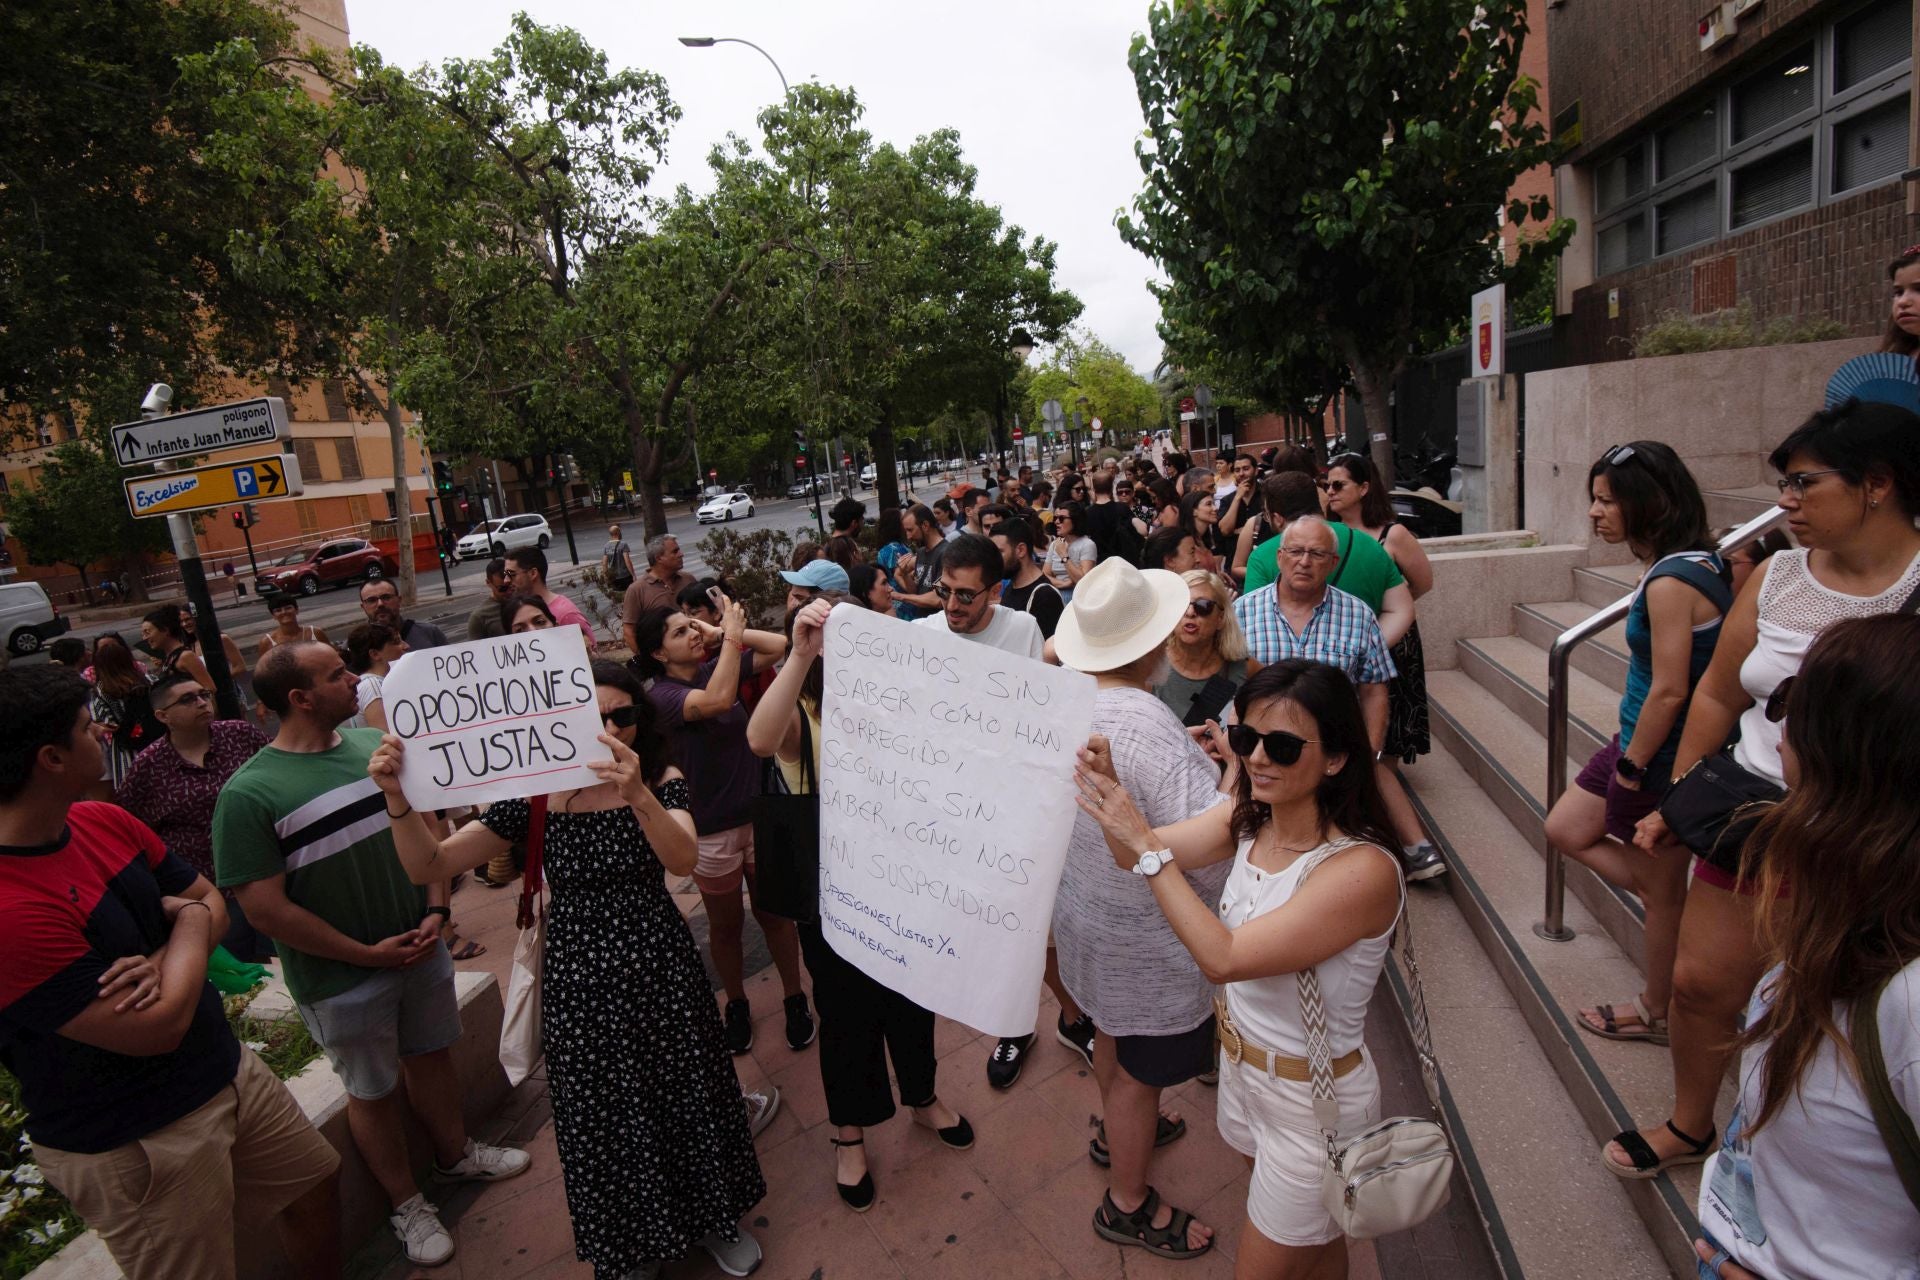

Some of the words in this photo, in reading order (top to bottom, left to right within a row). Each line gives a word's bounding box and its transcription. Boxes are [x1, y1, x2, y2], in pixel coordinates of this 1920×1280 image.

[146, 435, 190, 456] Infante
[193, 430, 221, 447] Juan
[223, 421, 271, 441] Manuel
[136, 478, 198, 508] Excelsior
[237, 472, 252, 493] P
[433, 650, 479, 682] POR
[492, 638, 546, 670] UNAS
[392, 667, 592, 739] OPOSICIONES
[834, 670, 917, 715] SABER
[1015, 719, 1061, 752] HAN
[428, 721, 577, 787] JUSTAS
[905, 821, 962, 855] CÓMO
[977, 843, 1035, 885] NOS
